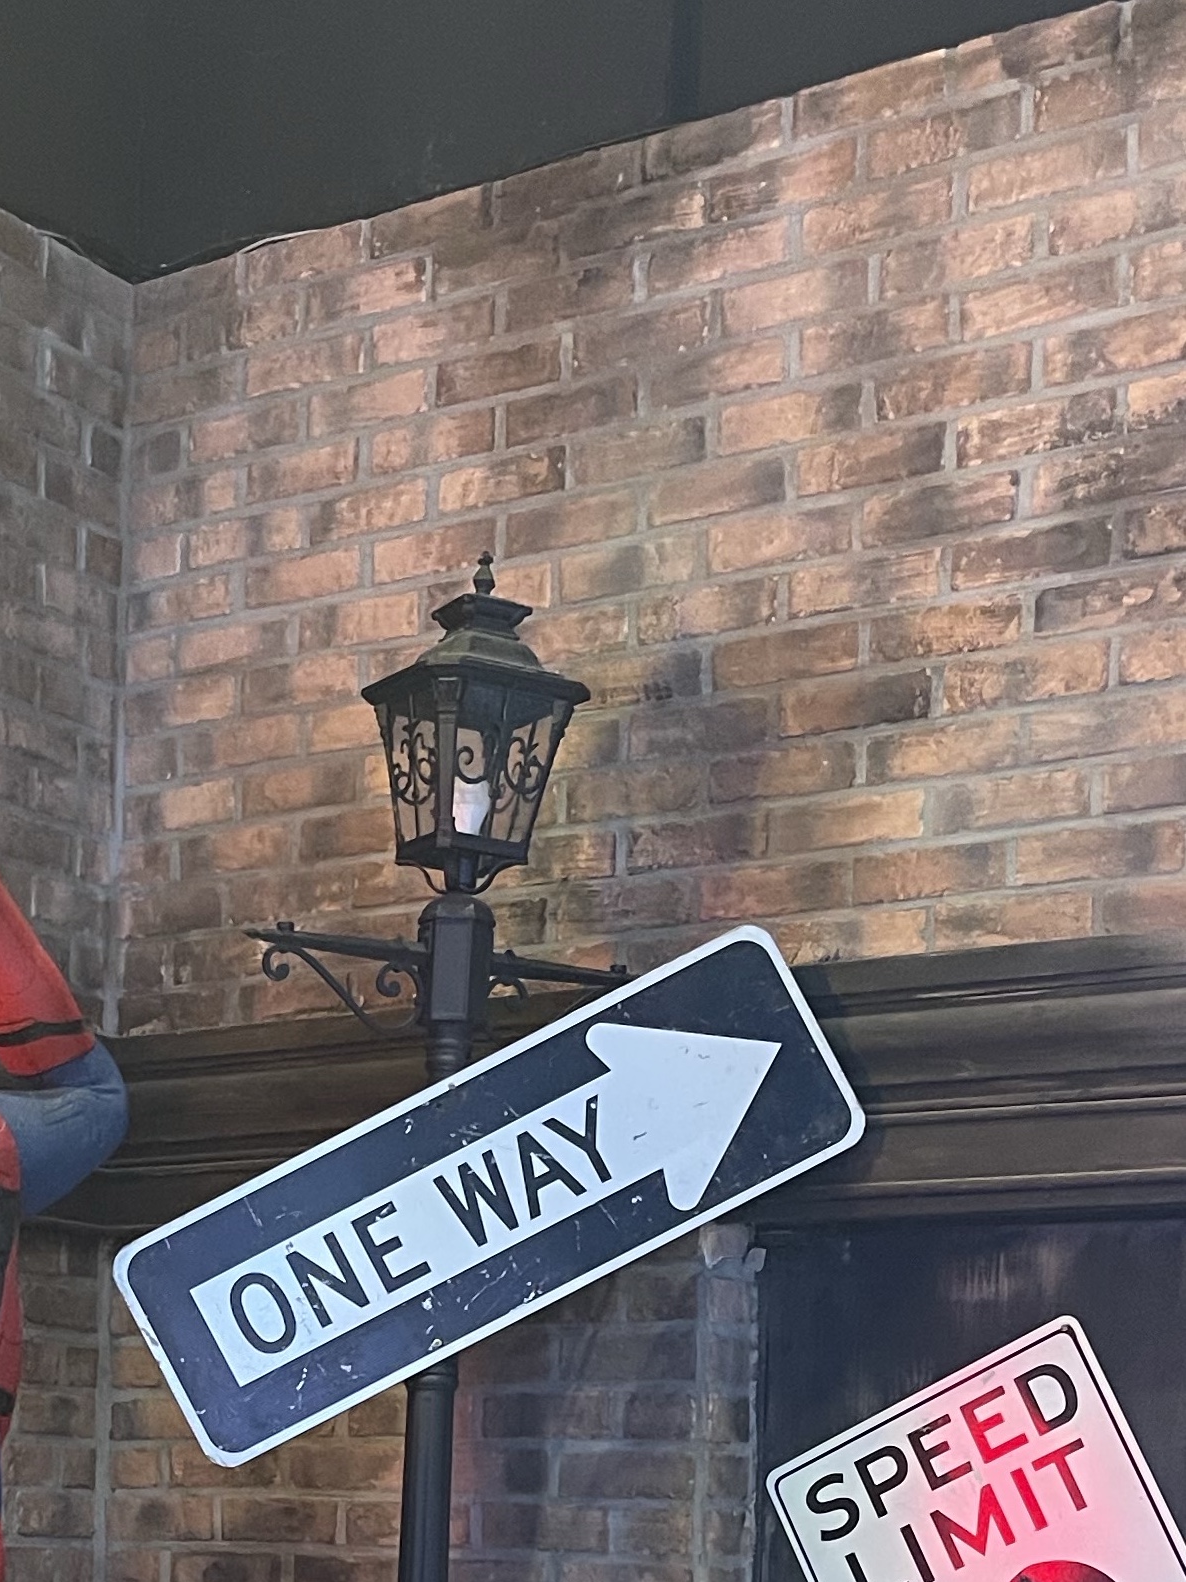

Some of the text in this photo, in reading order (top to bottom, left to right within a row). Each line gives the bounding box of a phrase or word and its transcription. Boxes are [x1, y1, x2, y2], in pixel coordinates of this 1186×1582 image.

[230, 1095, 613, 1354] ONE WAY
[806, 1364, 1078, 1542] SPEED
